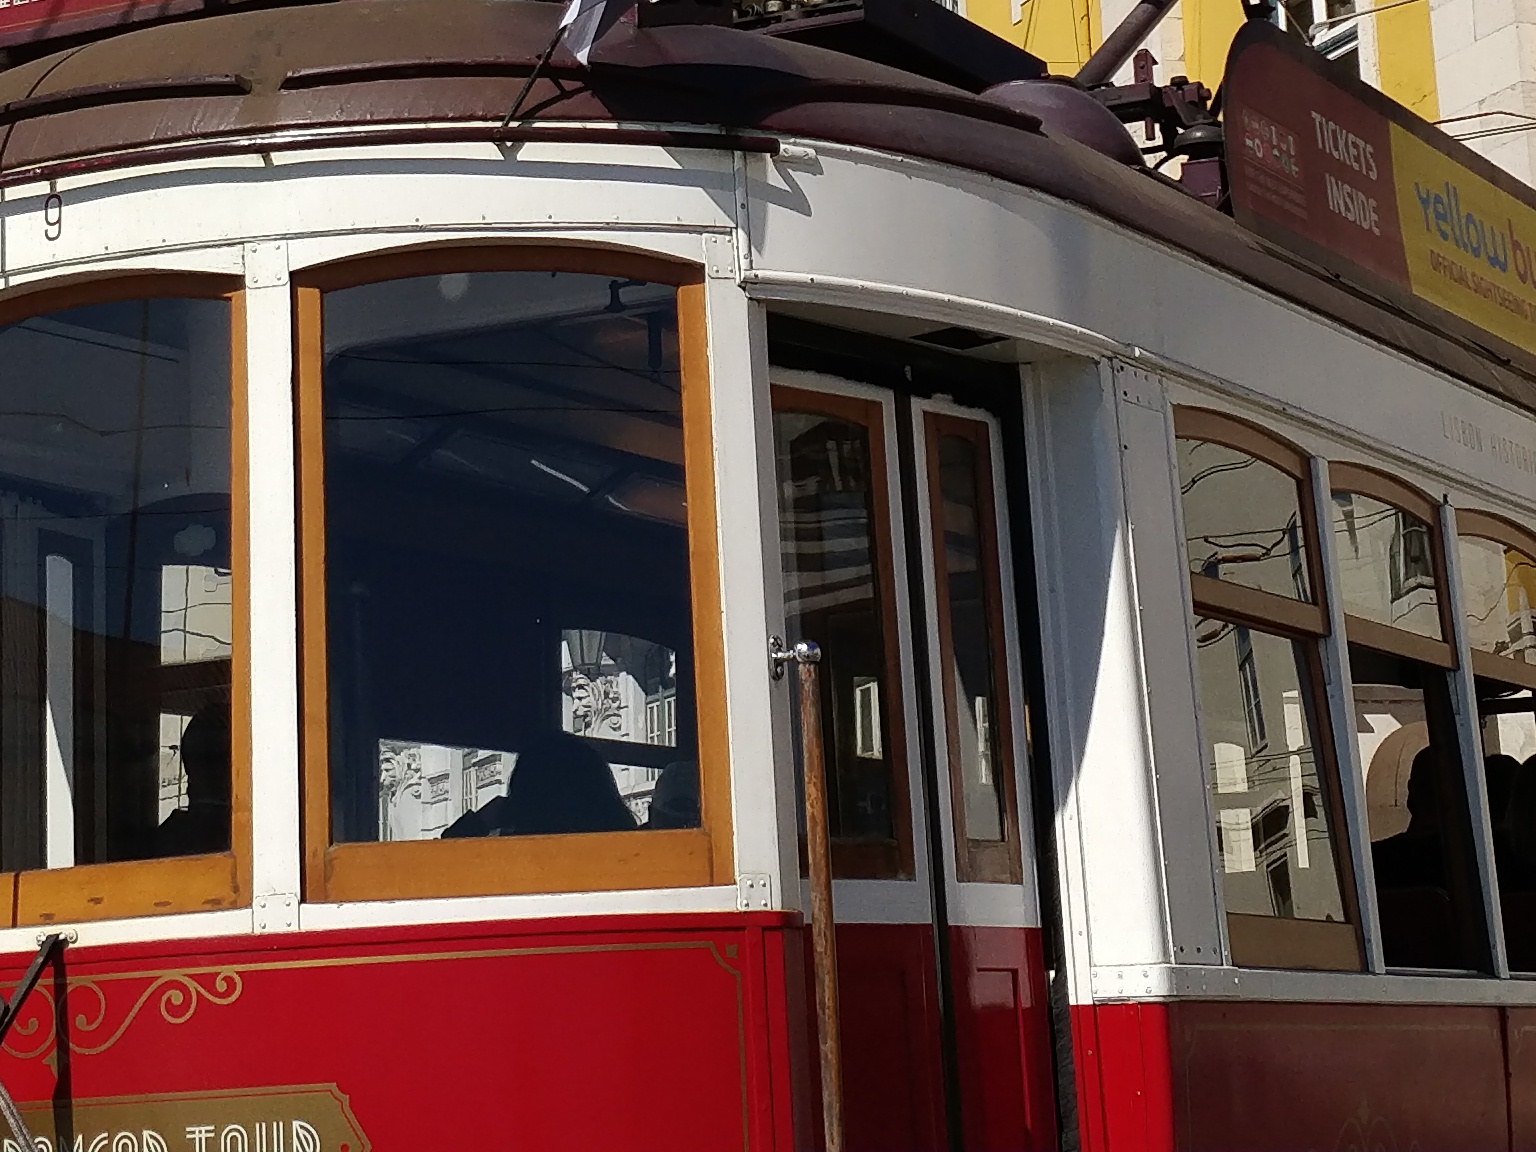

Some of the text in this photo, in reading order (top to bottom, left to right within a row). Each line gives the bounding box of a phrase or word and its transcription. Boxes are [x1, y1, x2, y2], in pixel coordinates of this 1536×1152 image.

[1310, 110, 1378, 181] TICKETS
[44, 193, 63, 242] 9
[1324, 171, 1381, 236] INSIDE
[1440, 409, 1484, 453] LISBON
